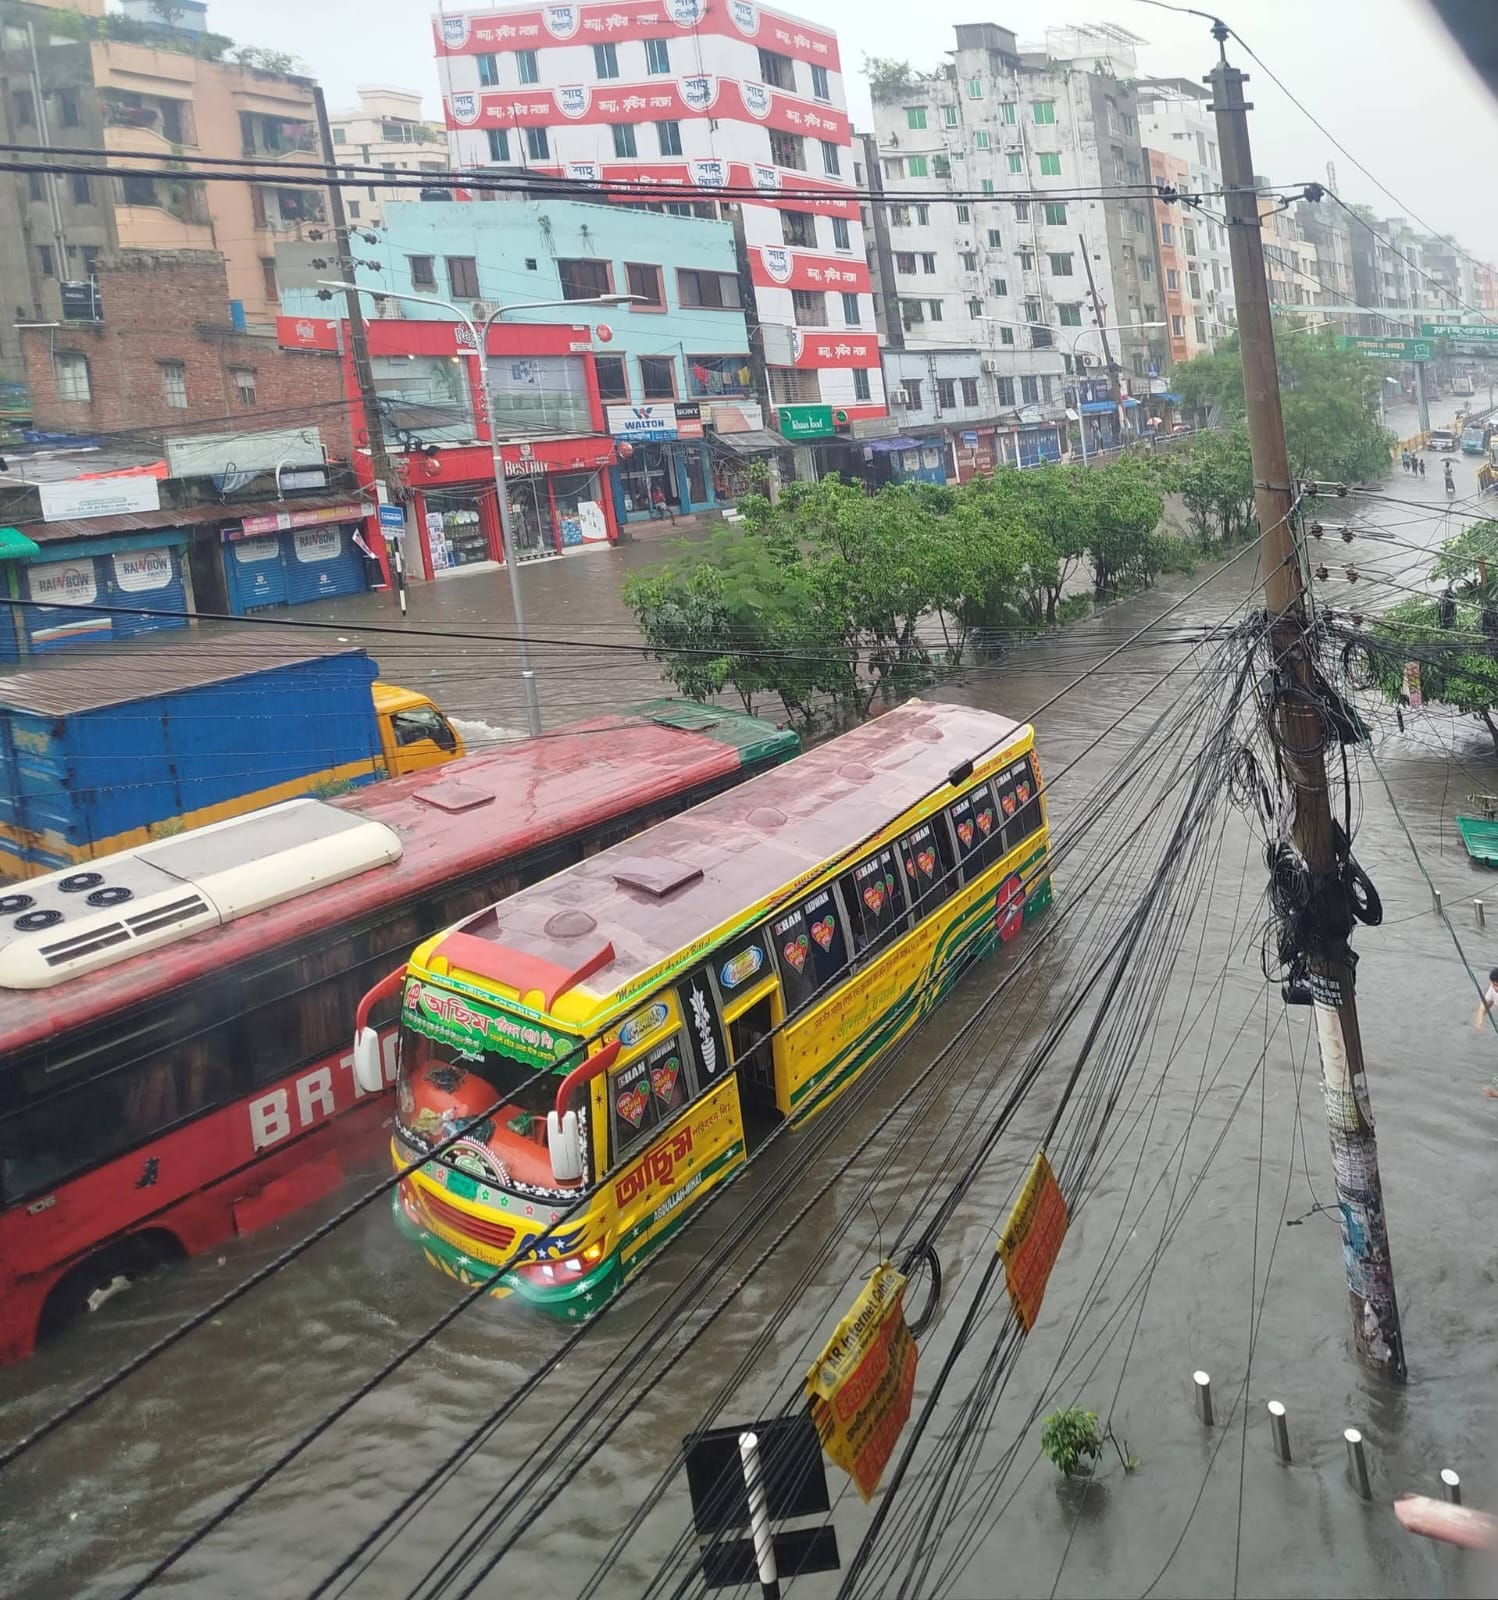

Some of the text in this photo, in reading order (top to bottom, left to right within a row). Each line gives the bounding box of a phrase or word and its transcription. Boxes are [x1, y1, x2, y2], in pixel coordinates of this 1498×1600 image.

[676, 408, 699, 416] SONY
[625, 420, 665, 430] WALTON
[300, 530, 336, 548] RAINBOW
[123, 557, 168, 575] RAINBOW
[39, 573, 90, 592] RAINBOW
[825, 1345, 846, 1368] AR
